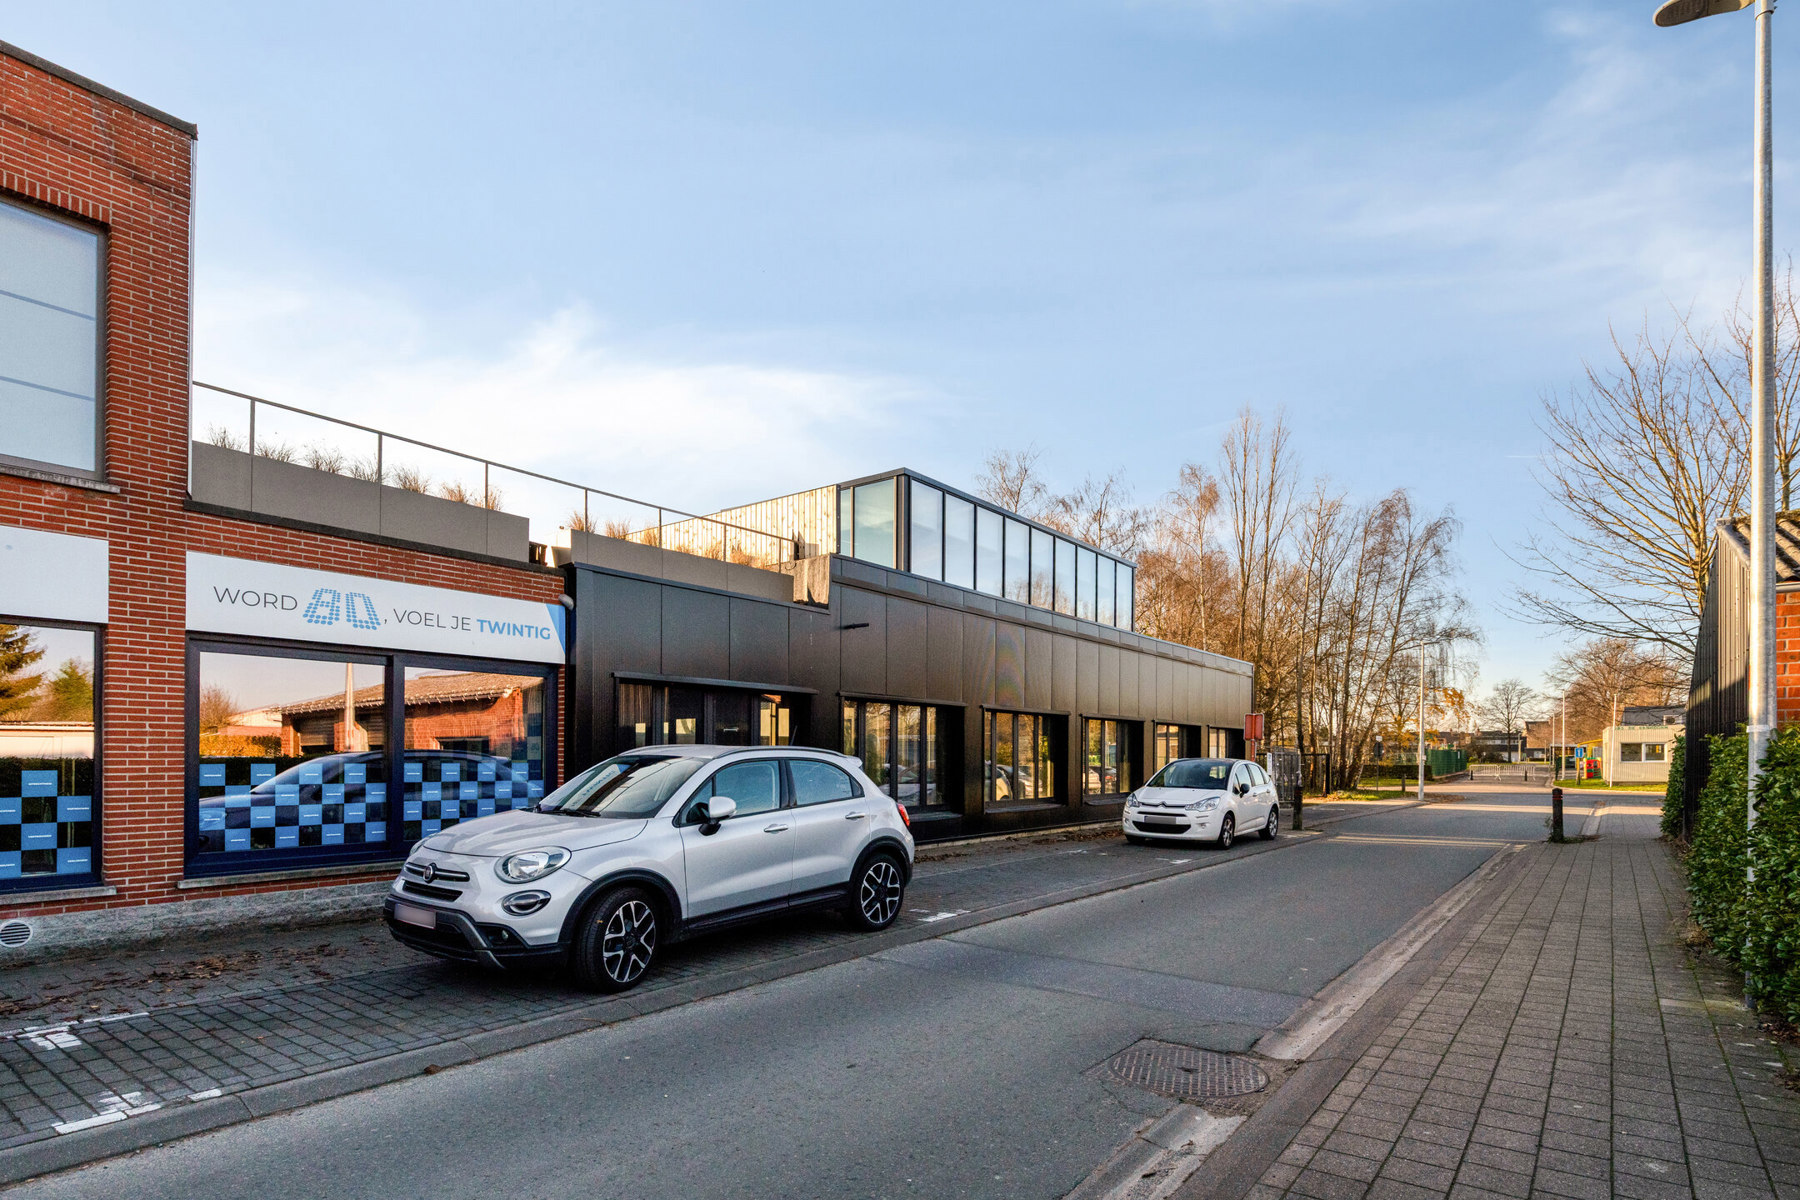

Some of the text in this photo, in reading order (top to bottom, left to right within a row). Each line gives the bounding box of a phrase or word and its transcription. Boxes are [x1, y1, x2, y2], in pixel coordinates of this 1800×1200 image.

[213, 585, 298, 611] WORD
[393, 608, 446, 629] VOEL
[450, 615, 471, 631] JE
[476, 618, 551, 640] TWINTIG
